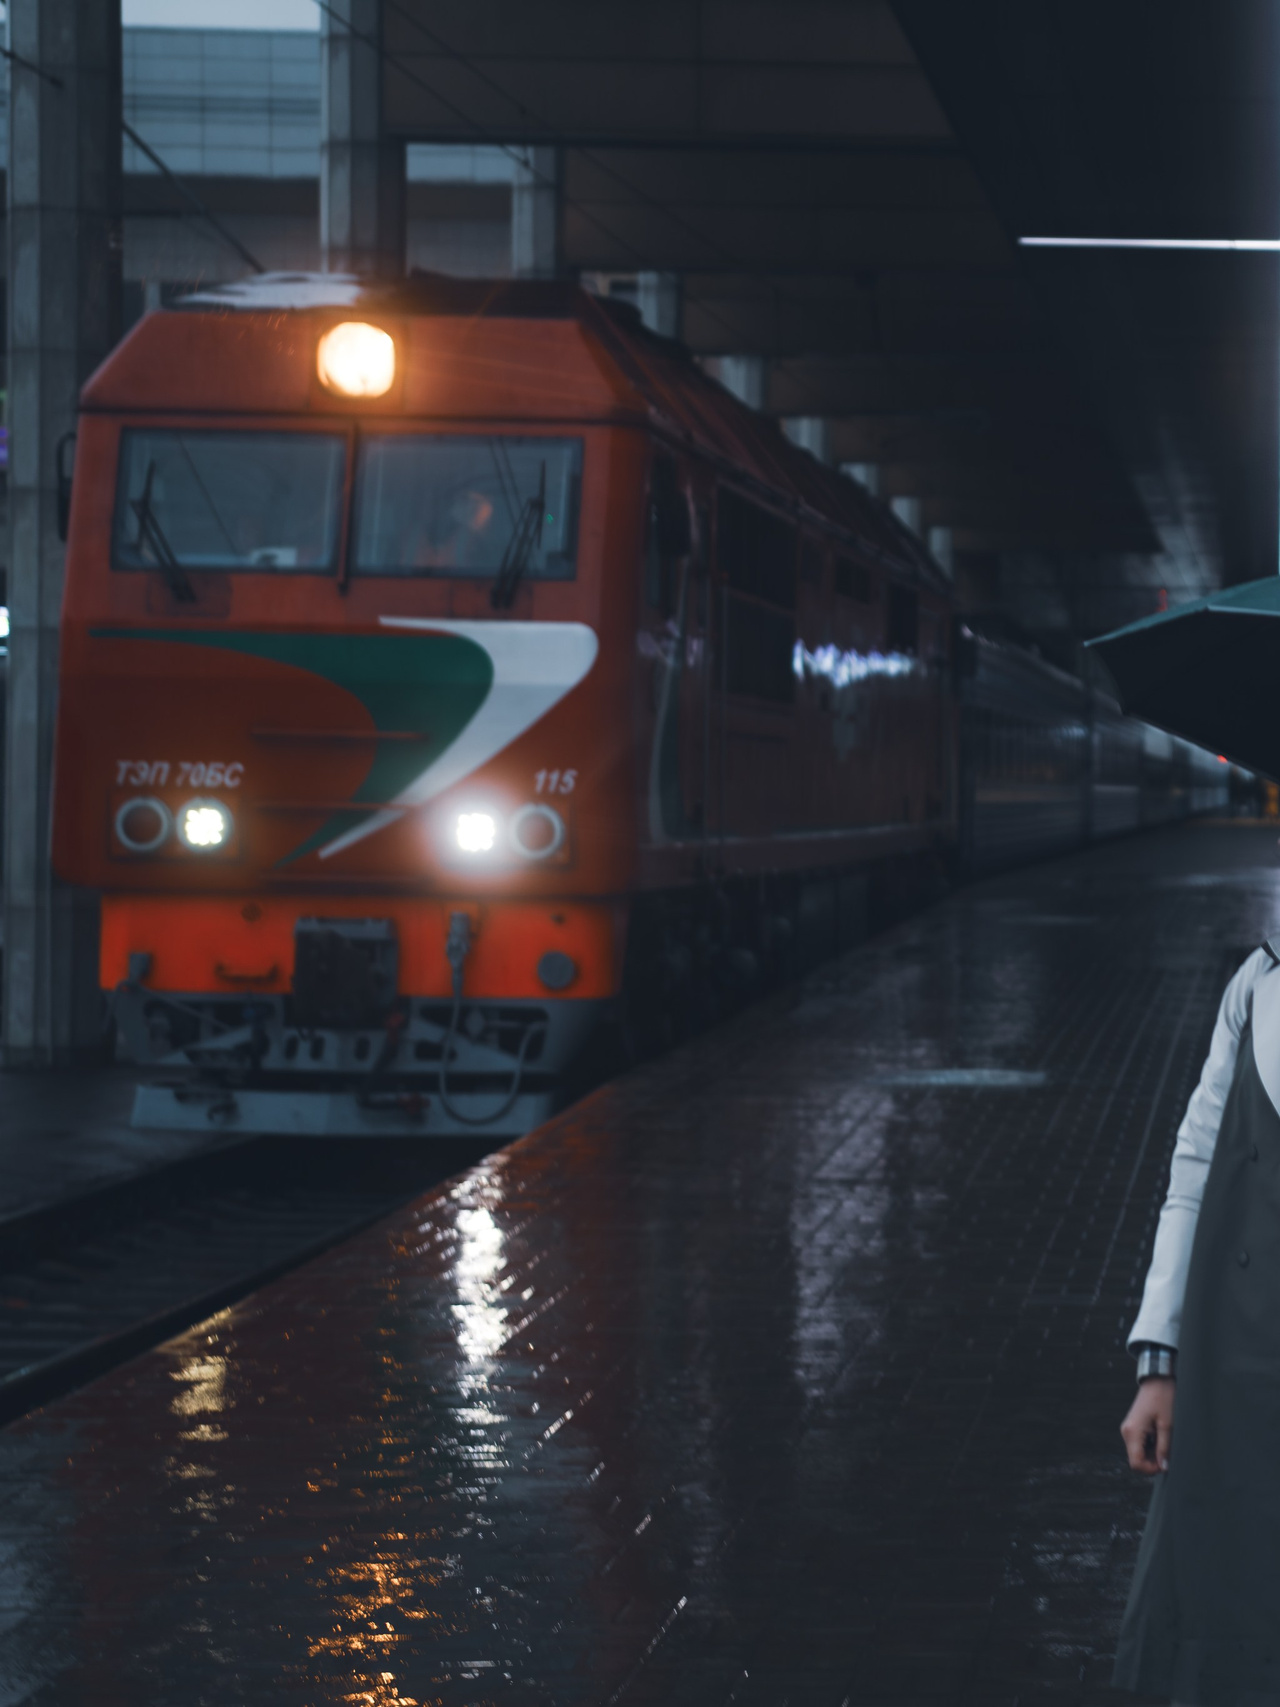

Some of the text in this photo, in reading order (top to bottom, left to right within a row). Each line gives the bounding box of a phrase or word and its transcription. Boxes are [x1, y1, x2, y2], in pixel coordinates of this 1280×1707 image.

[116, 760, 244, 788] ТЭП 70БС
[534, 768, 578, 795] 115
